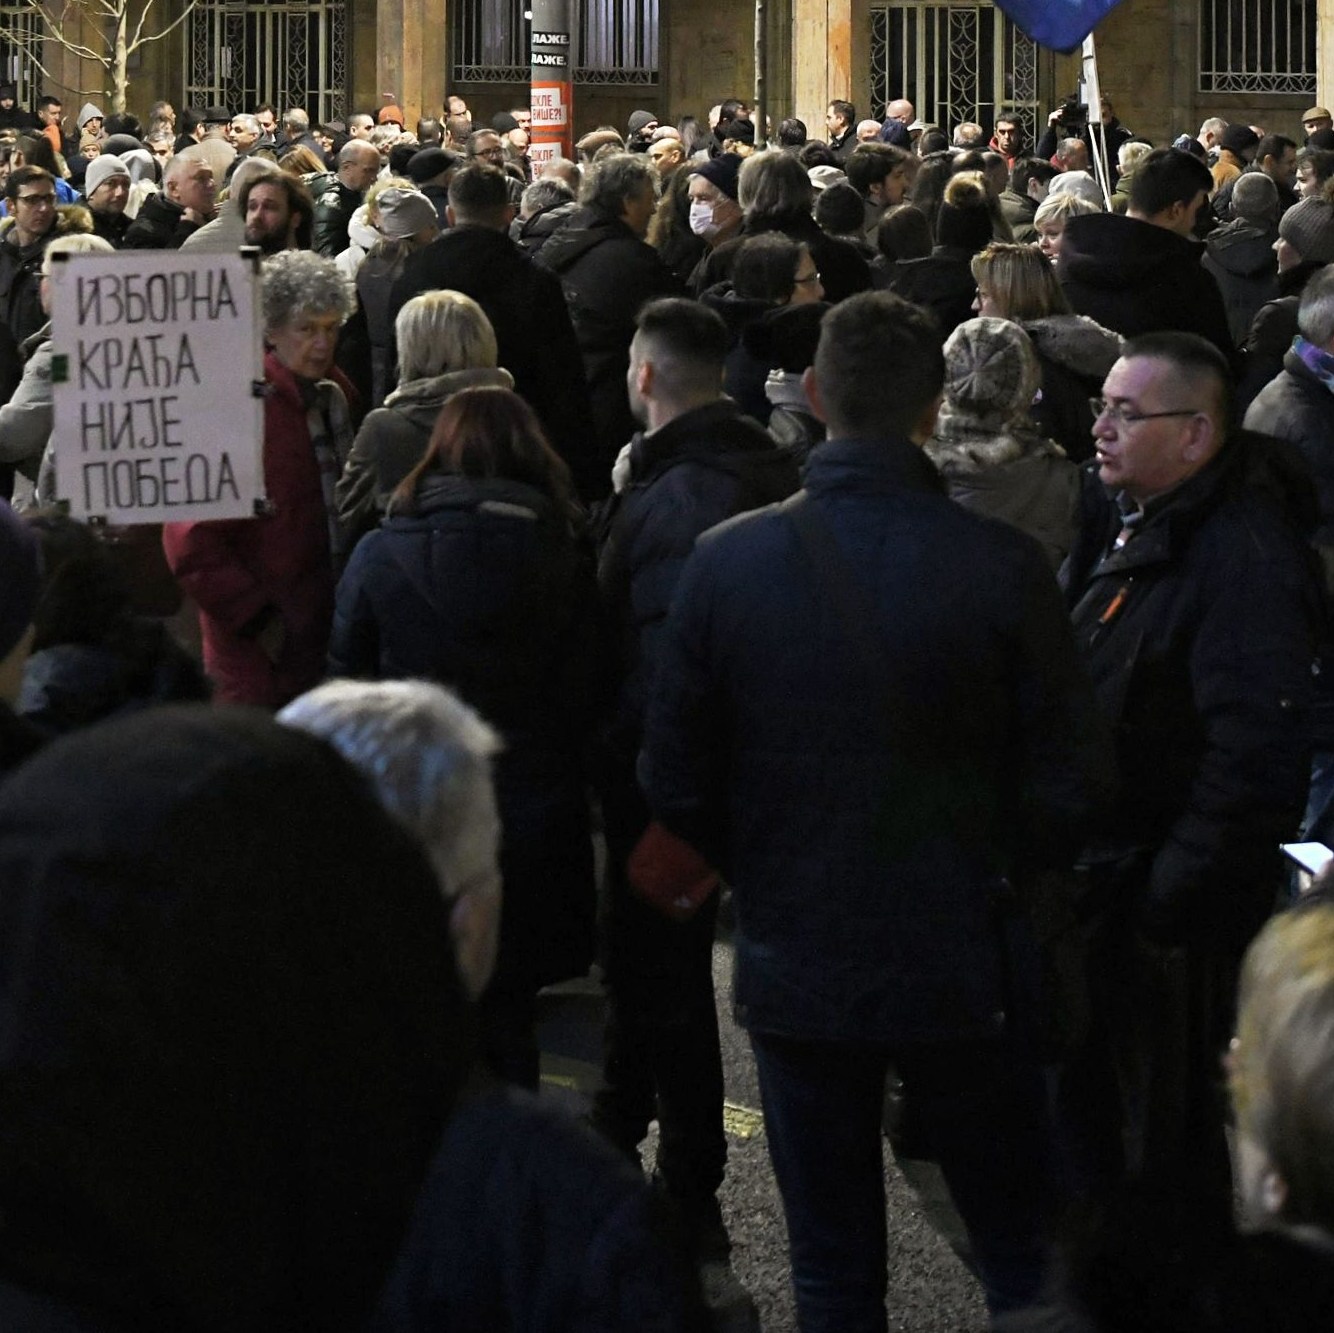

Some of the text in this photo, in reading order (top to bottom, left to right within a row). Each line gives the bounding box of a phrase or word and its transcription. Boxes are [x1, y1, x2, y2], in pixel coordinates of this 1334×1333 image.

[77, 268, 238, 326] ИЗБОРНА
[78, 333, 201, 390] КРАЂА
[81, 396, 182, 452] НИЈЕ
[82, 451, 240, 510] ПОБЕДА
